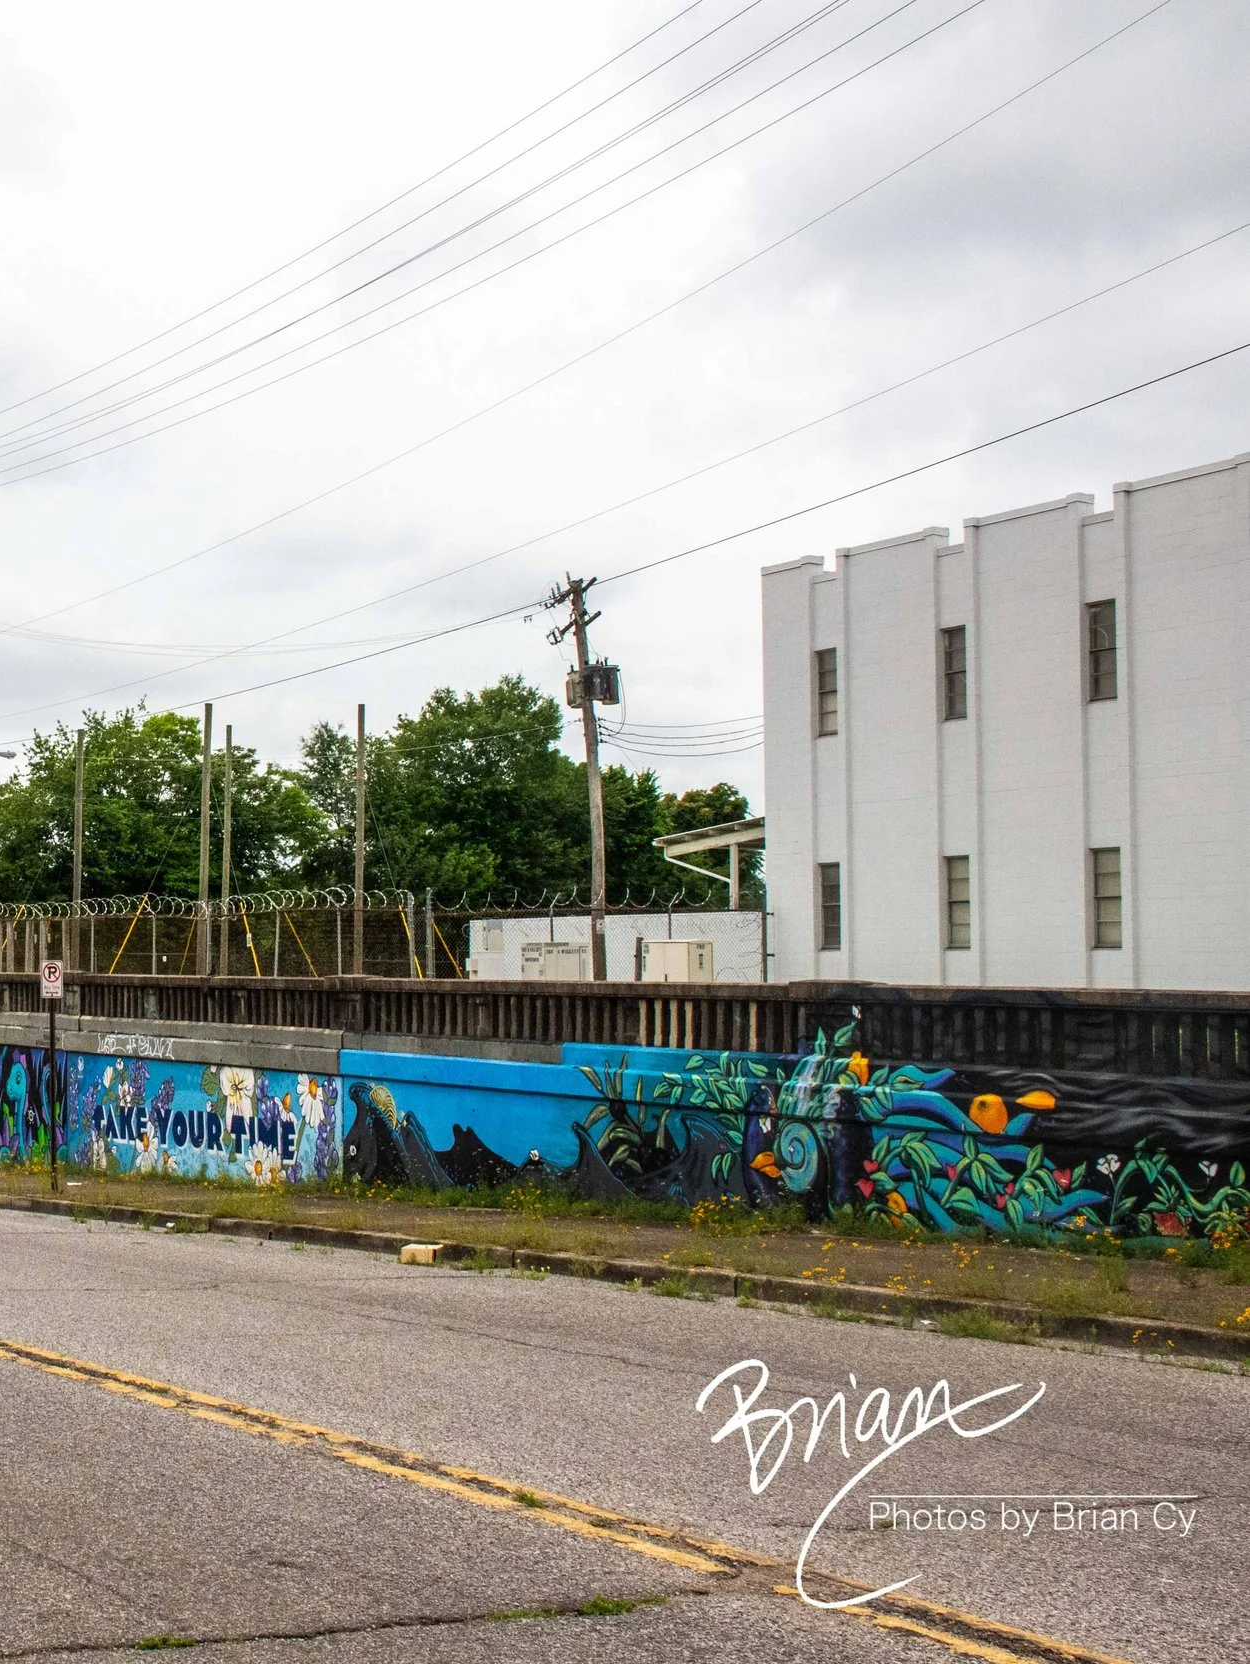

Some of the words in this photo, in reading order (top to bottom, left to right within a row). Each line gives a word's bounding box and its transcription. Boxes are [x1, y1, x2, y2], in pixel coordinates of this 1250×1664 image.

[92, 1104, 149, 1144] TAKE
[155, 1108, 225, 1151] YOUR
[230, 1114, 297, 1163] TIME
